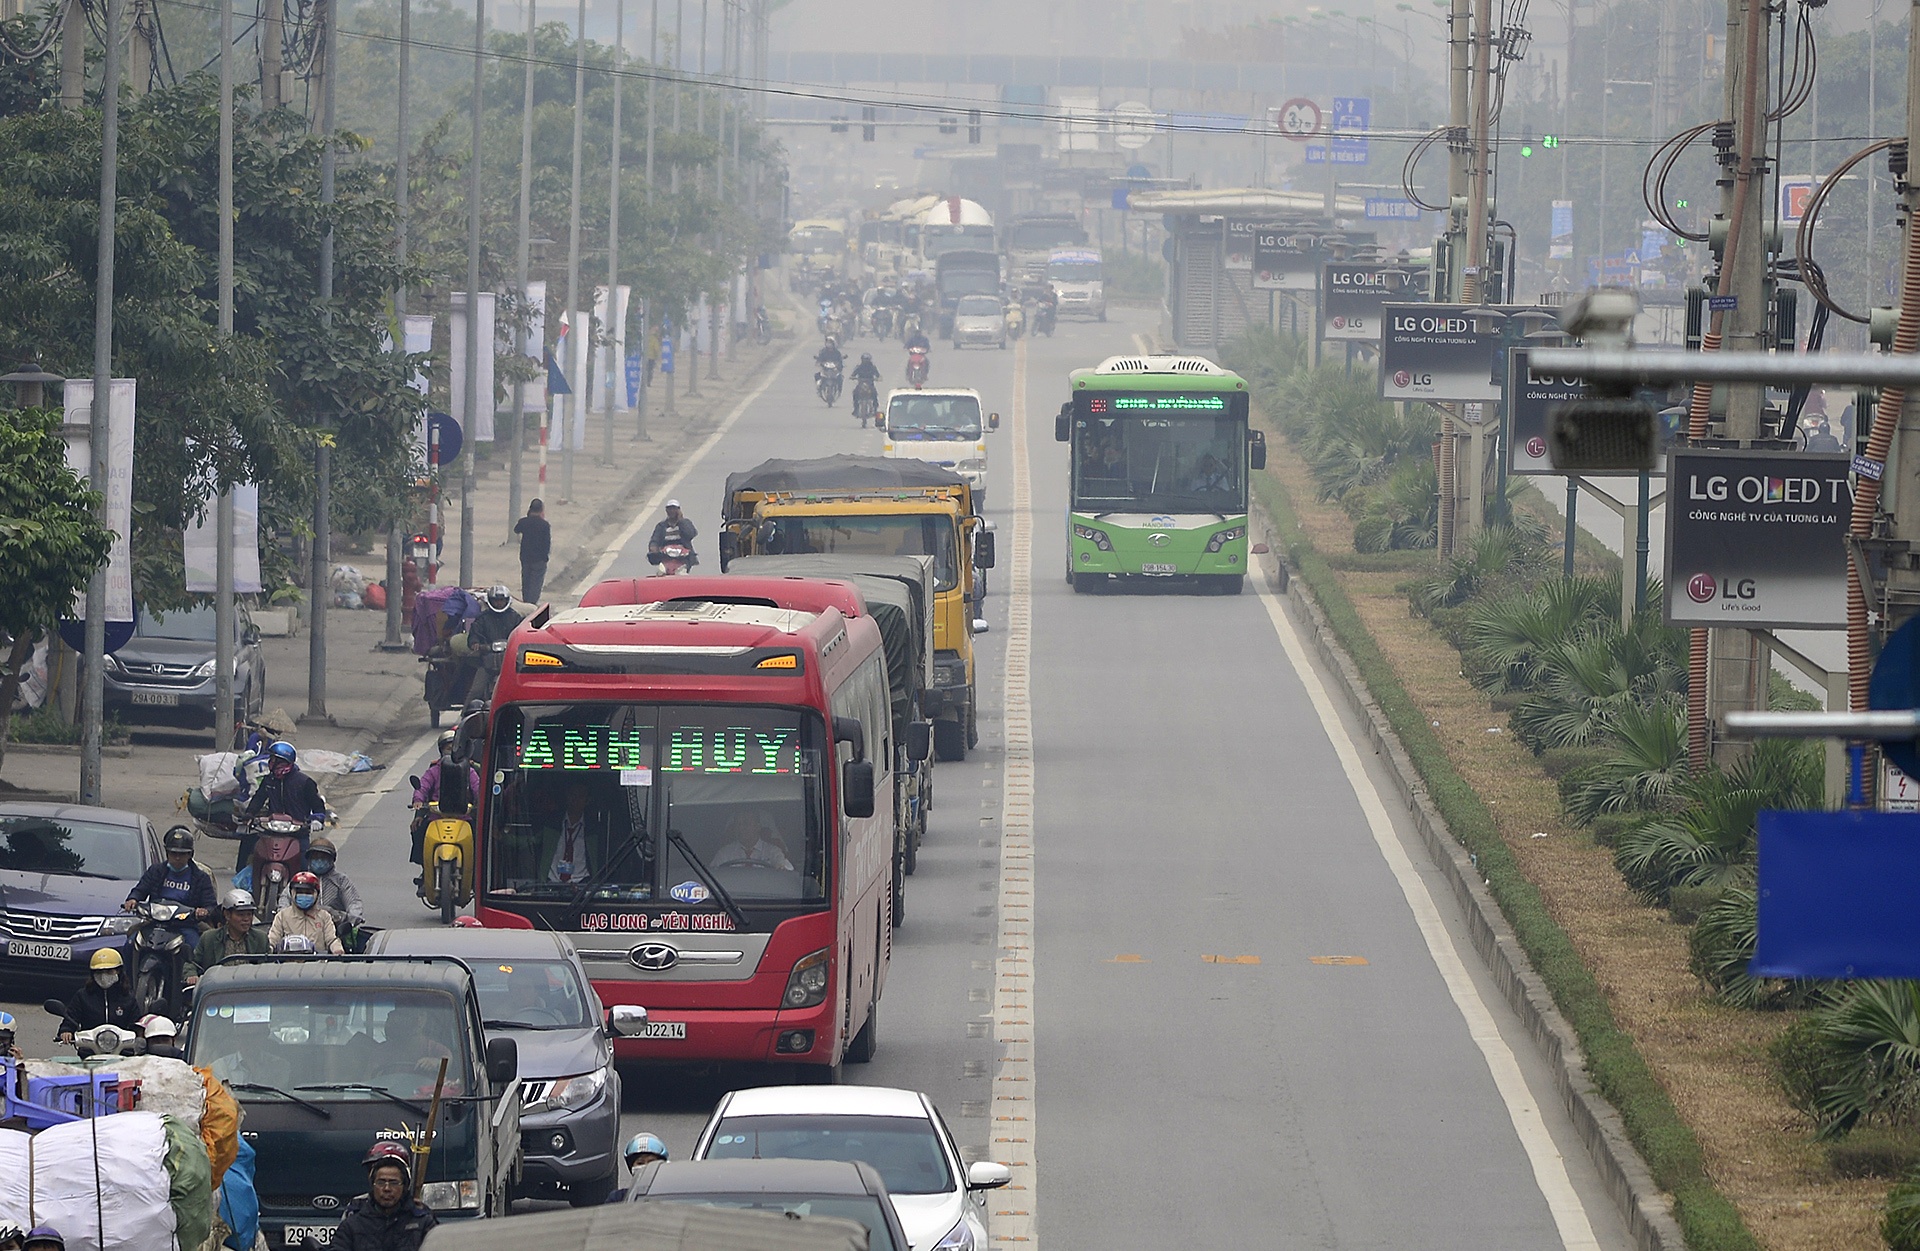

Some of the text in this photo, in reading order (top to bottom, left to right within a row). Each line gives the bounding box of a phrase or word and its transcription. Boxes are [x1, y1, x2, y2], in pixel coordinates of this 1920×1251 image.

[1259, 235, 1275, 247] LG
[1271, 272, 1285, 281] LG
[1332, 273, 1350, 285] LG
[1348, 318, 1363, 328] LG
[1394, 316, 1416, 331] LG
[1420, 316, 1468, 333] OLED
[1394, 335, 1410, 343] CÔNG
[1412, 373, 1432, 386] LG
[1526, 390, 1547, 399] CÔNG
[1569, 392, 1578, 400] TV
[1689, 474, 1728, 501] LG
[1737, 475, 1821, 504] OLED
[1688, 509, 1717, 521] CÔNG
[1719, 510, 1746, 522] NGHỆ
[1749, 513, 1761, 522] TV
[1763, 511, 1783, 522] CỦA
[1821, 515, 1837, 524] LAI
[1722, 578, 1756, 600] LG
[1721, 603, 1761, 612] Life's Good
[522, 730, 788, 768] ANH HUY
[581, 912, 609, 932] LẠC
[610, 913, 648, 930] LONG
[660, 911, 690, 931] YÊN
[10, 942, 70, 960] 30A-030.22
[317, 1199, 336, 1208] KIA
